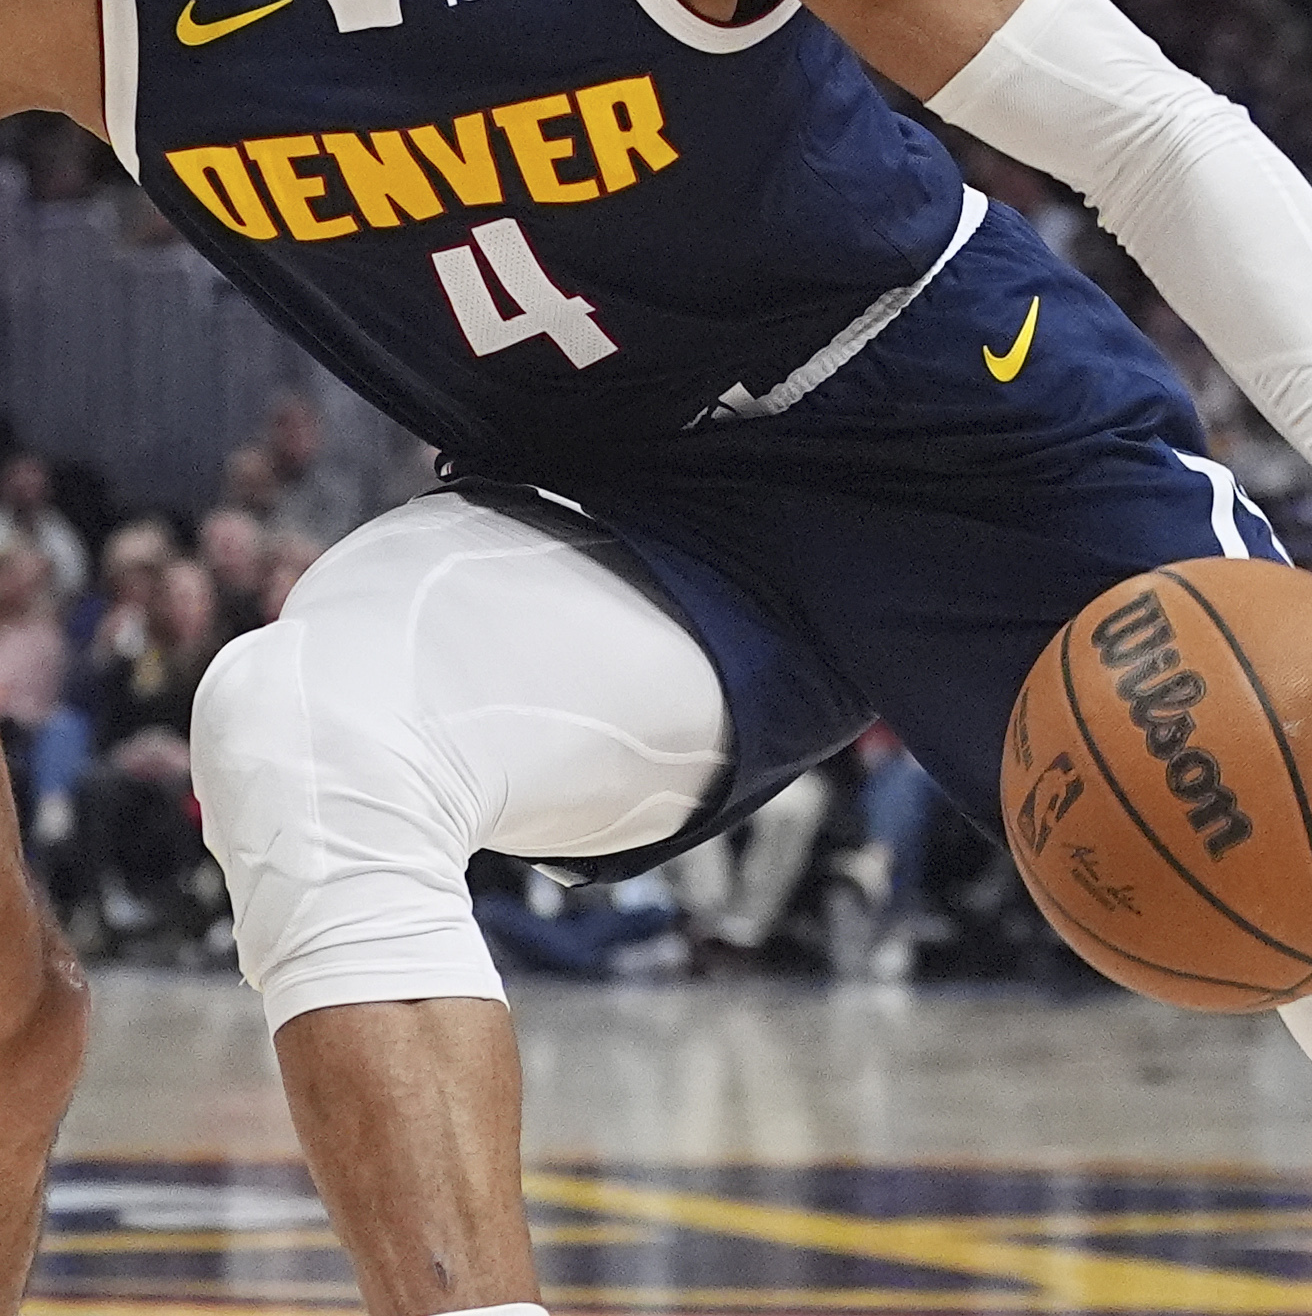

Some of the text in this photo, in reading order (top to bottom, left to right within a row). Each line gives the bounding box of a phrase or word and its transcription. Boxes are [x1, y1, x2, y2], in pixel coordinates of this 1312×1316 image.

[164, 73, 680, 242] DENVER
[430, 216, 620, 370] 4
[1090, 588, 1254, 864] Wilson
